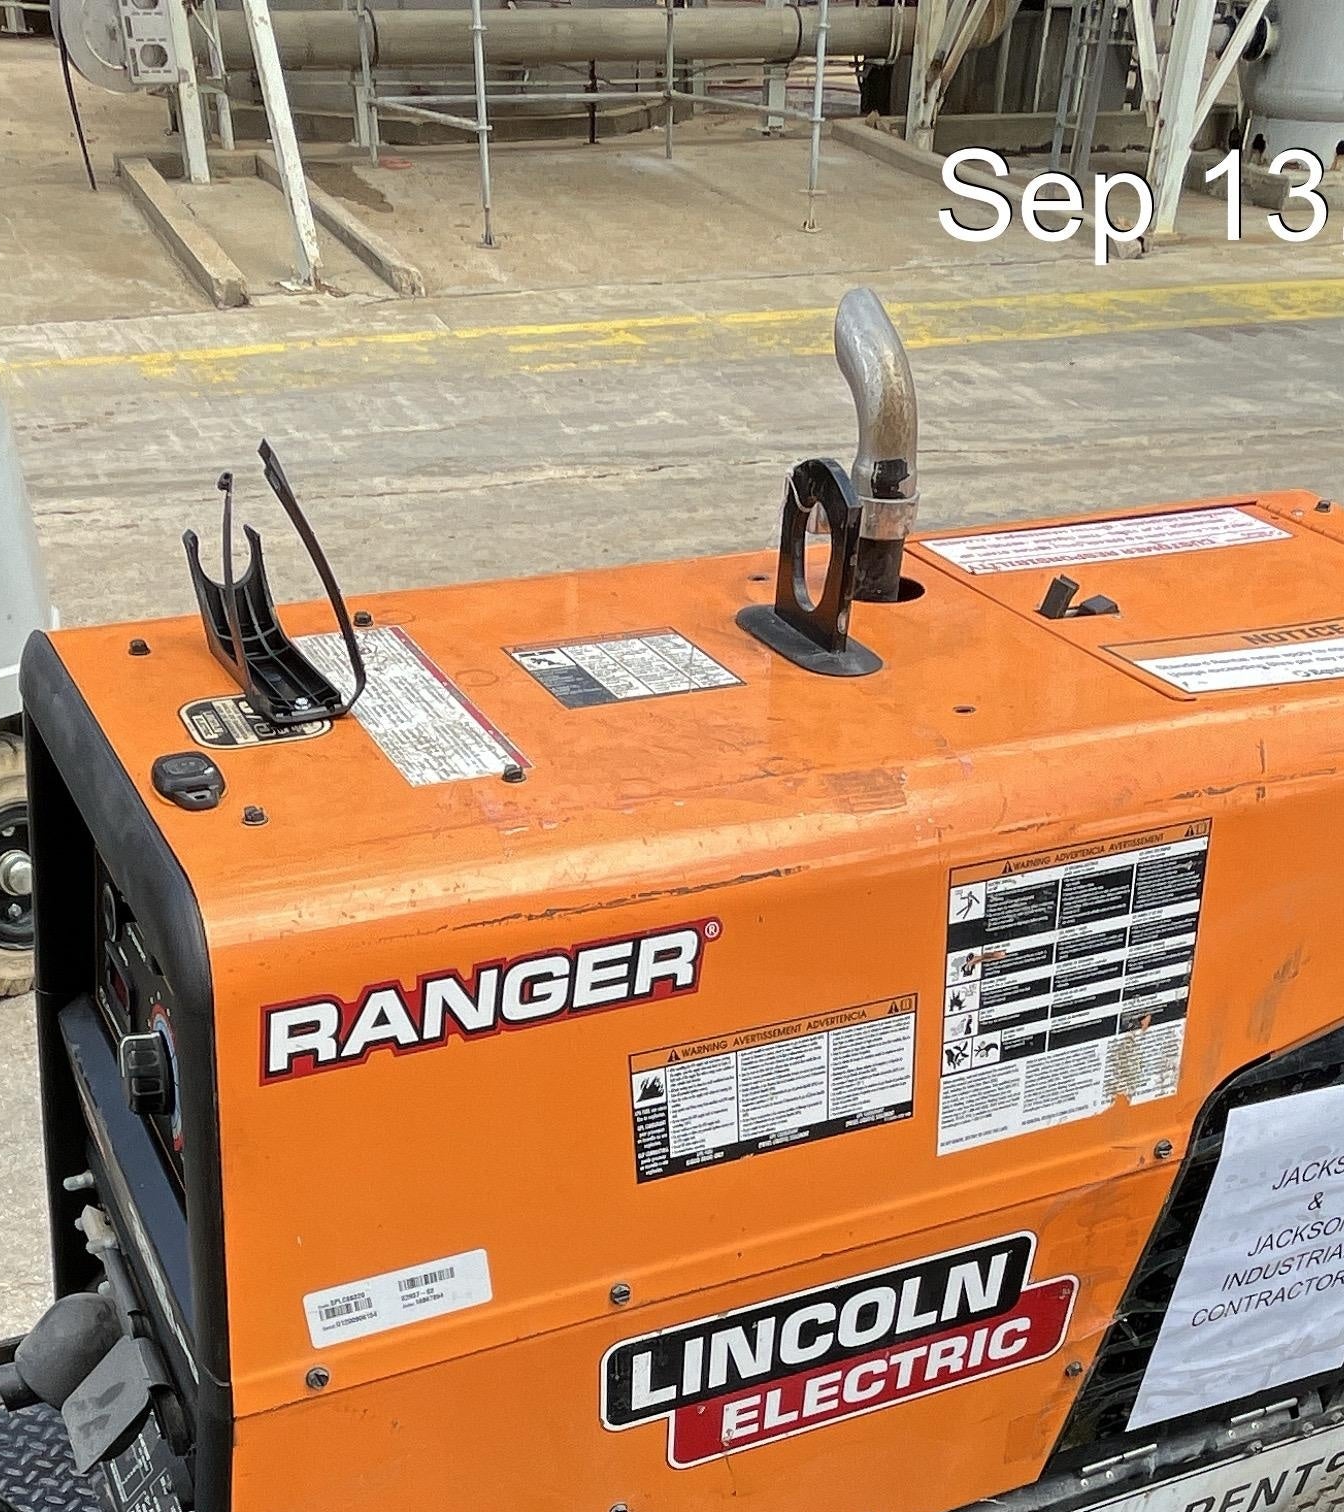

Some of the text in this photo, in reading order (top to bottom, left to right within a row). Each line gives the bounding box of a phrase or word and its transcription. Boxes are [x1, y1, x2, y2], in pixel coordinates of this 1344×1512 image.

[968, 550, 1119, 571] RESPONSIBILITY
[1123, 537, 1216, 555] CUSTOMER
[1012, 833, 1165, 871] WARNING ADVERTENCIA AVERTISSEMENT
[268, 928, 699, 1074] RANGER
[680, 1009, 867, 1058] WARNING AVERTISSEMENT ADVERTENCIA
[1307, 1191, 1324, 1211] &
[631, 1252, 1010, 1411] LINCOLN
[720, 1316, 1032, 1444] ELECTRIC
